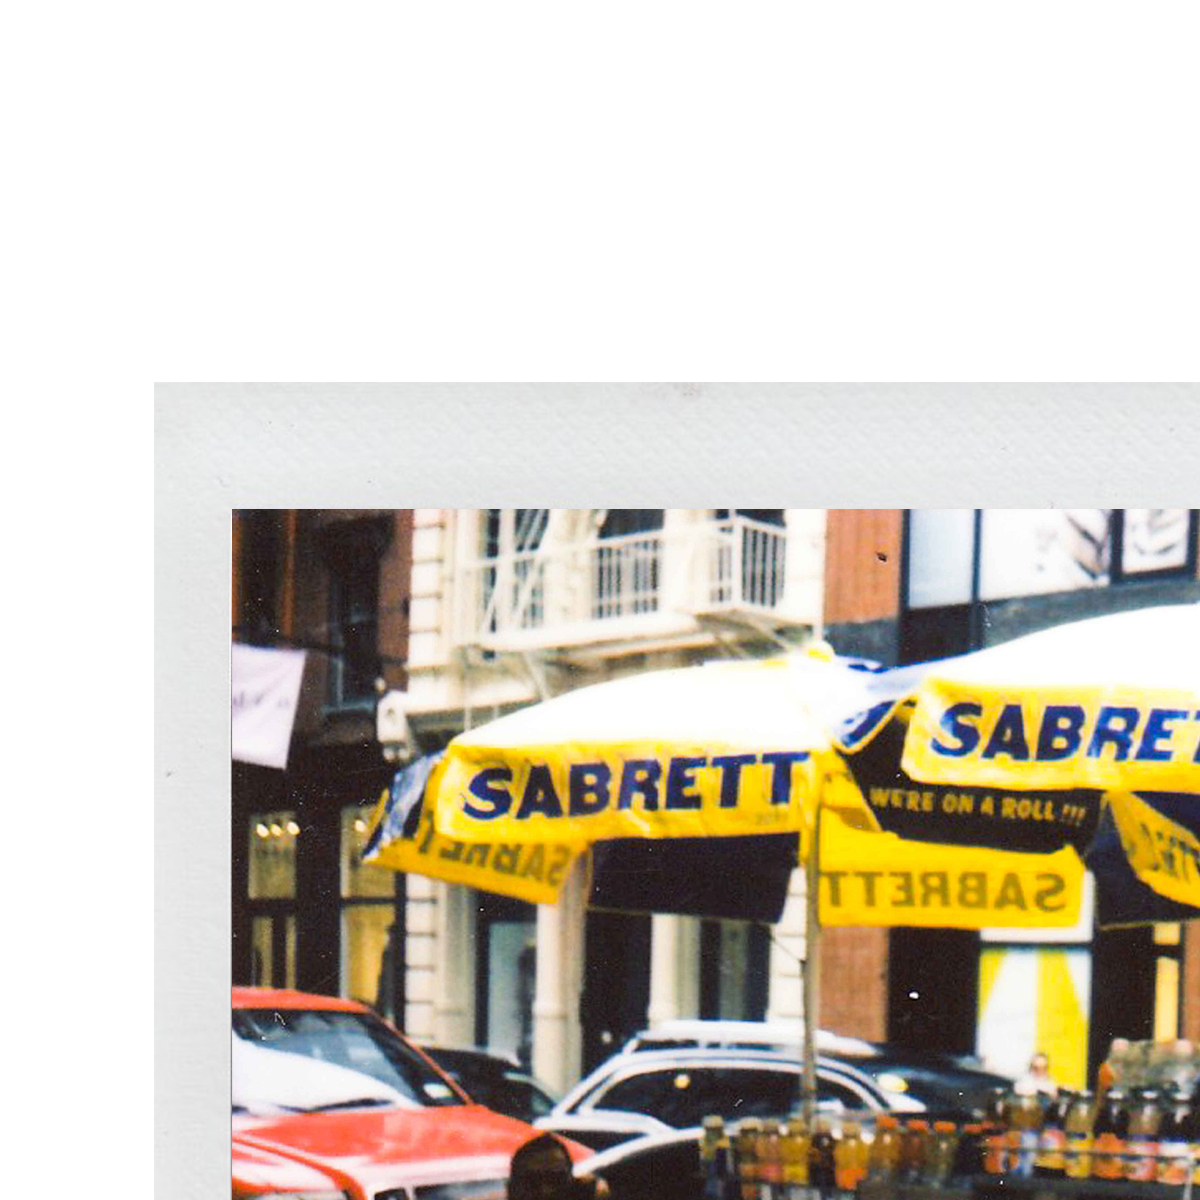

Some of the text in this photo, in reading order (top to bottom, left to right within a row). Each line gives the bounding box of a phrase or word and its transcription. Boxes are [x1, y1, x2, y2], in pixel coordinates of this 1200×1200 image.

[463, 752, 811, 821] SABRETT
[942, 793, 974, 815] ON
[980, 796, 995, 817] A
[1001, 796, 1055, 822] ROLL
